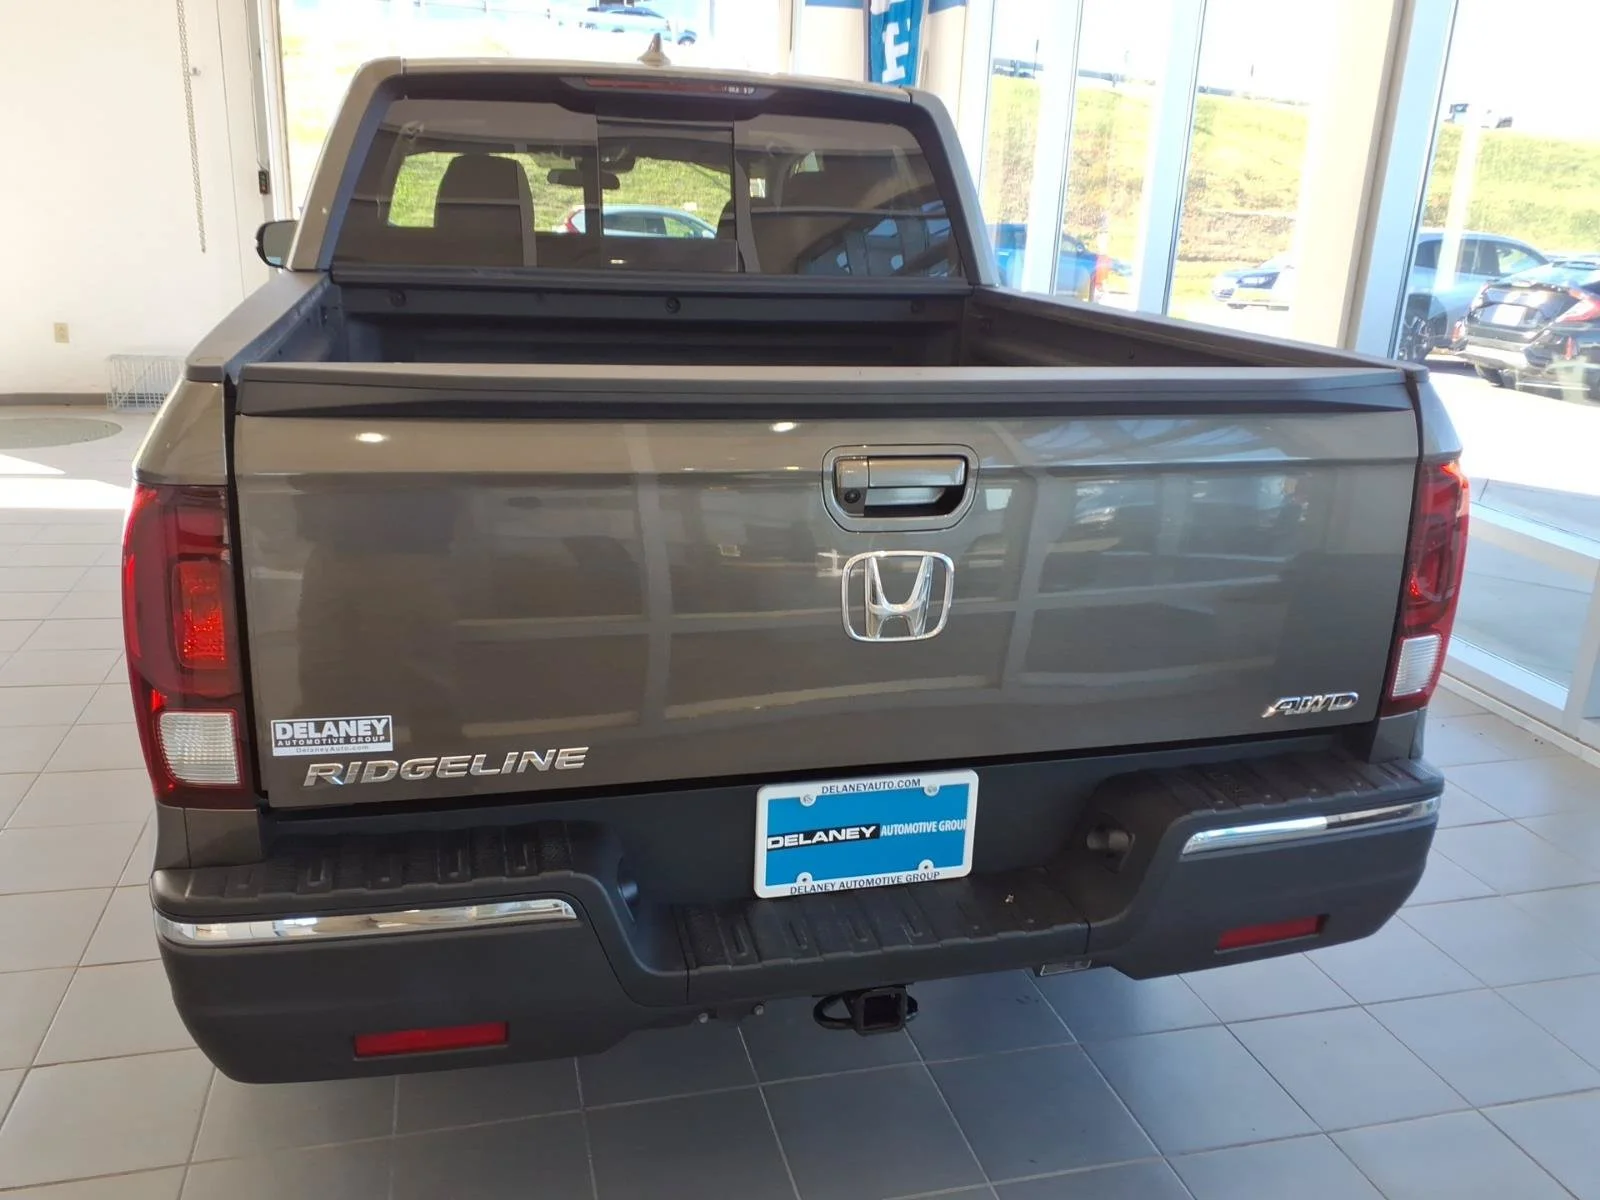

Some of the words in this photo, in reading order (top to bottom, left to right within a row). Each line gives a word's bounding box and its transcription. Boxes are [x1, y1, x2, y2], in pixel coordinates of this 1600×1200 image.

[1261, 691, 1359, 718] AWD
[275, 719, 389, 740] DELANEY
[277, 738, 345, 746] AUTOMOTIVE
[350, 735, 386, 743] GROUP
[303, 746, 590, 787] RIDGELINE
[821, 778, 922, 794] DELANEYAUTO.COM
[767, 825, 877, 850] DELANEY
[880, 820, 938, 837] AUTOMOTIVE
[790, 882, 836, 895] DELANEY
[838, 874, 904, 890] AUTOMOTIVE
[905, 871, 941, 883] GROUP
